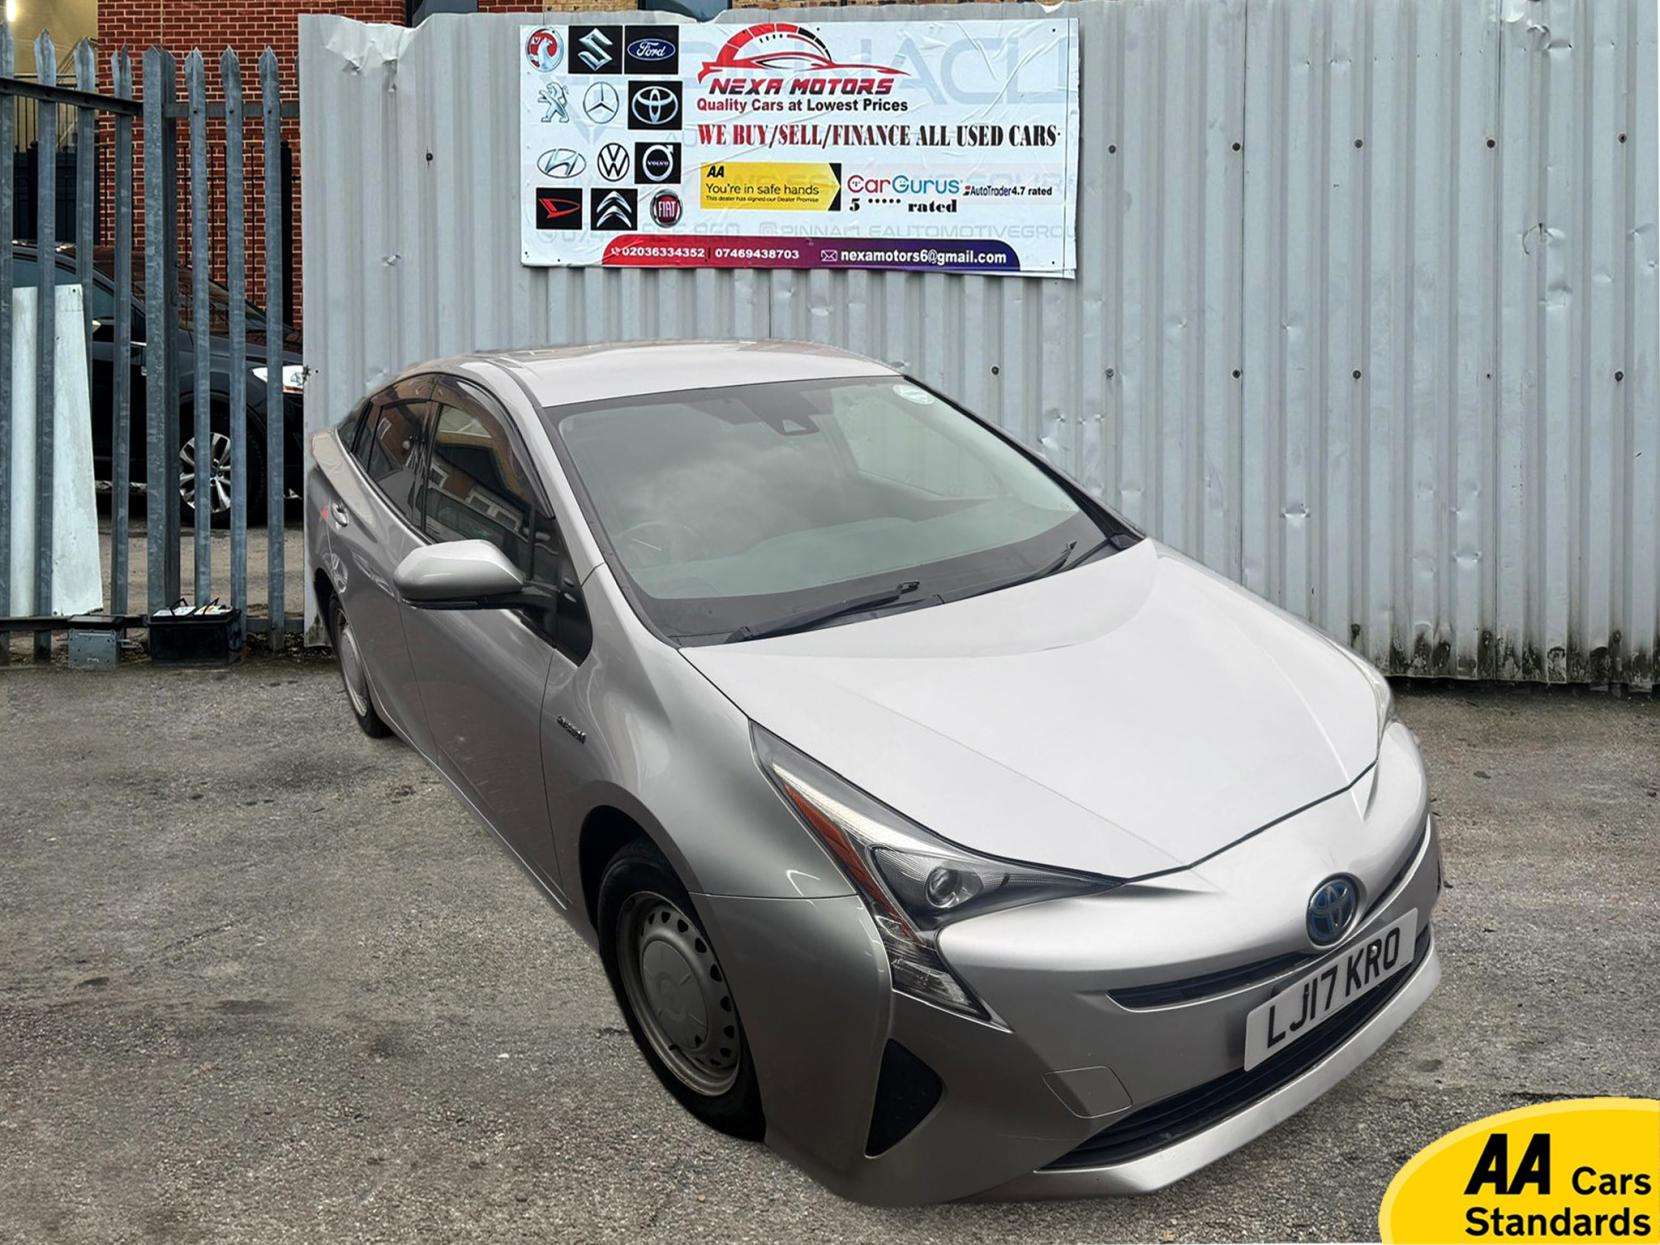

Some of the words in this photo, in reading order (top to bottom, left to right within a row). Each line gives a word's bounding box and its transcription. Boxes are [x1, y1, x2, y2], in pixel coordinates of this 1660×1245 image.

[636, 40, 666, 57] Ford
[709, 78, 783, 95] NEXA
[789, 78, 894, 95] MOTORS
[697, 98, 747, 114] Quality
[752, 98, 783, 111] Cars
[789, 98, 802, 111] at
[807, 99, 858, 111] Lowest
[863, 99, 908, 111] Prices
[697, 124, 726, 146] WE
[916, 125, 950, 146] ALL
[956, 125, 1003, 147] USED
[707, 166, 725, 178] AA
[706, 183, 741, 194] You're
[744, 183, 754, 194] in
[757, 183, 781, 195] safe
[784, 184, 819, 195] hands
[847, 174, 960, 194] CarGurus
[1028, 186, 1053, 197] rated
[658, 201, 677, 218] FIAT
[849, 198, 861, 212] 5
[908, 199, 958, 213] rated
[622, 247, 705, 257] 02036334352
[715, 248, 799, 259] 07469438703
[841, 249, 1006, 265] nexamotors6@gmail.com
[1267, 964, 1339, 1049] LJ17
[1345, 926, 1401, 998] KRO
